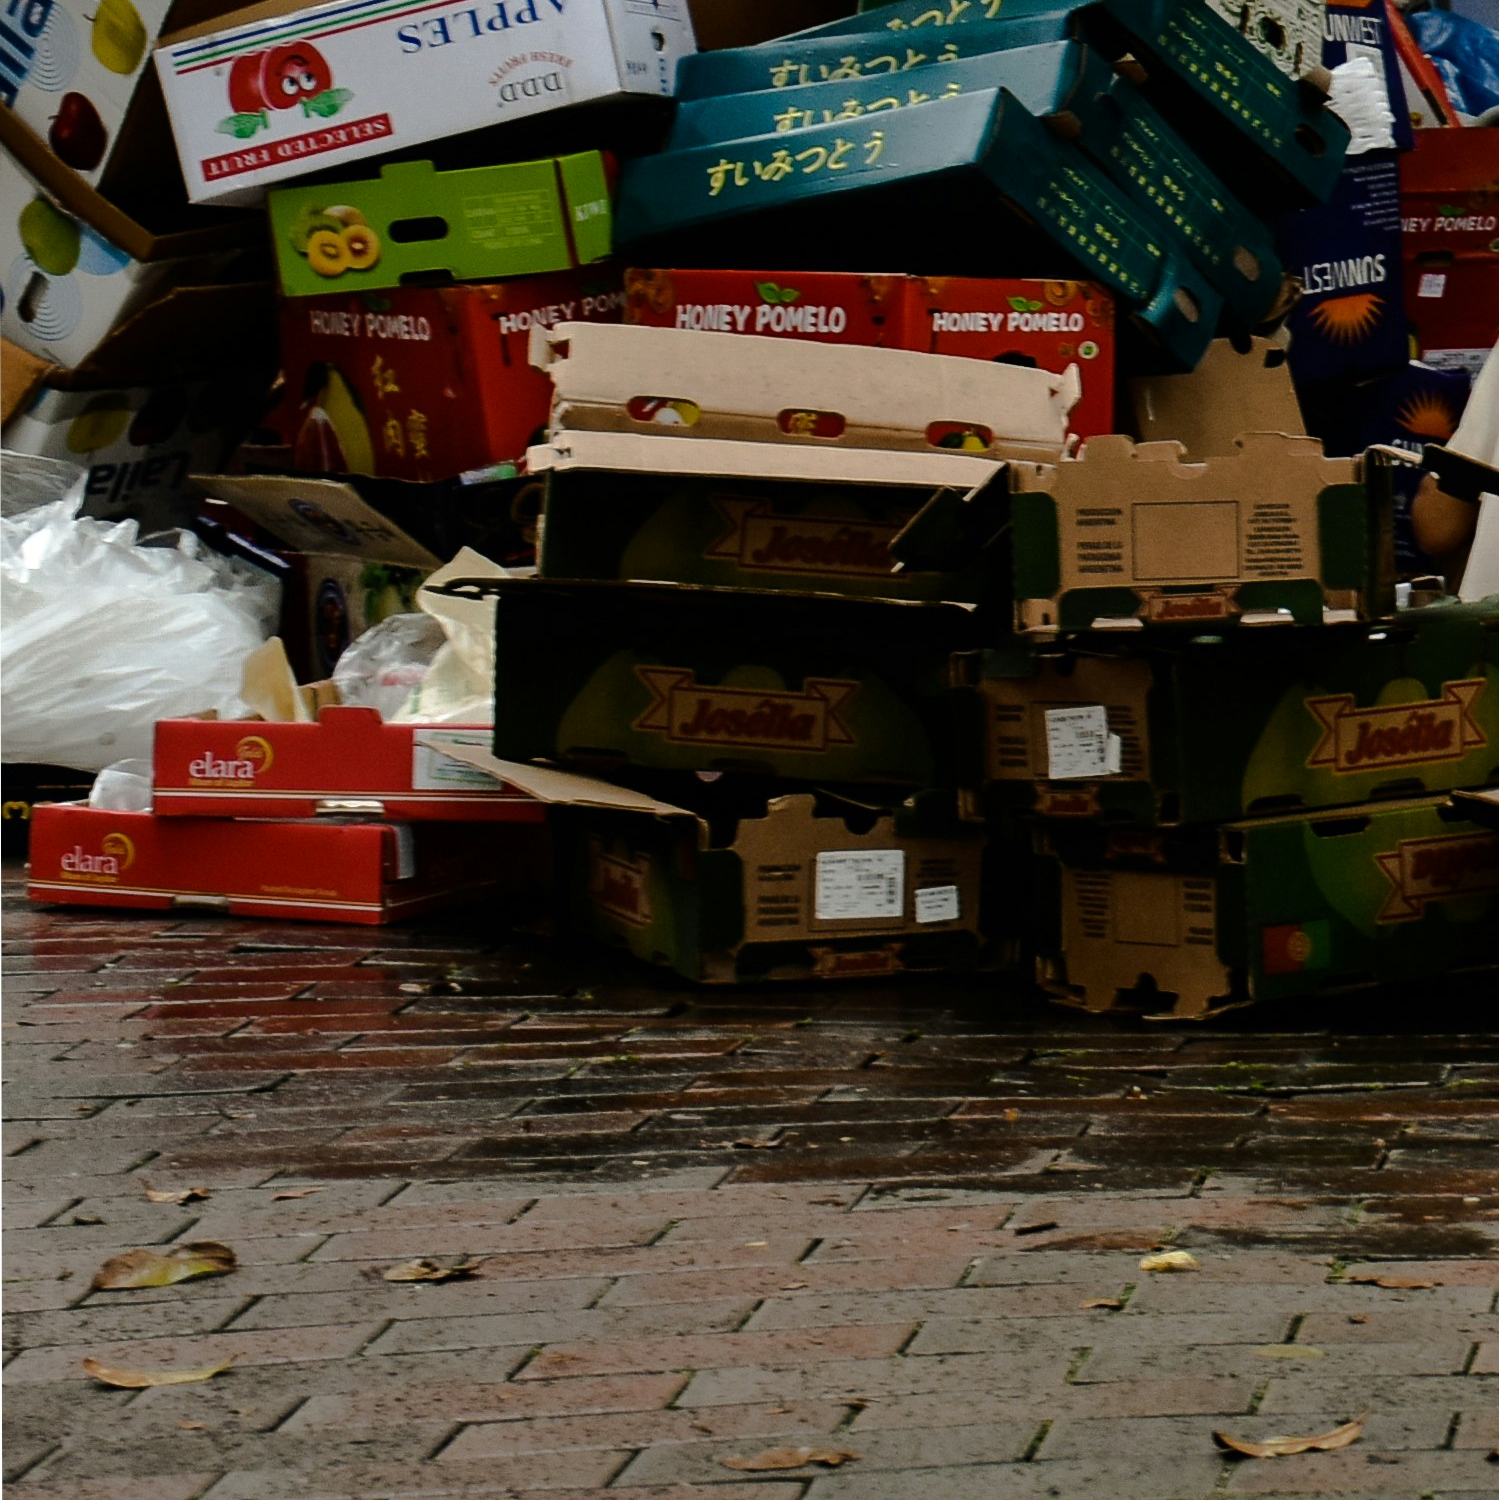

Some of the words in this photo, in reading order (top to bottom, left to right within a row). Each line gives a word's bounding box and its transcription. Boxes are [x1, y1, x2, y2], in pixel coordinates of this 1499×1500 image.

[1322, 13, 1384, 45] UNWEST
[276, 118, 388, 159] SELECTED
[206, 149, 272, 179] FRUIT
[706, 131, 886, 198] すいみつとう
[1303, 252, 1387, 295] SUNWEST
[310, 309, 360, 338] HONEY
[366, 311, 431, 342] POMELO
[675, 303, 750, 332] HONEY
[754, 303, 846, 335] POMELO
[932, 311, 1004, 333] HONEY
[1006, 311, 1085, 333] POMELO
[188, 750, 255, 780] elara
[60, 844, 119, 875] elara
